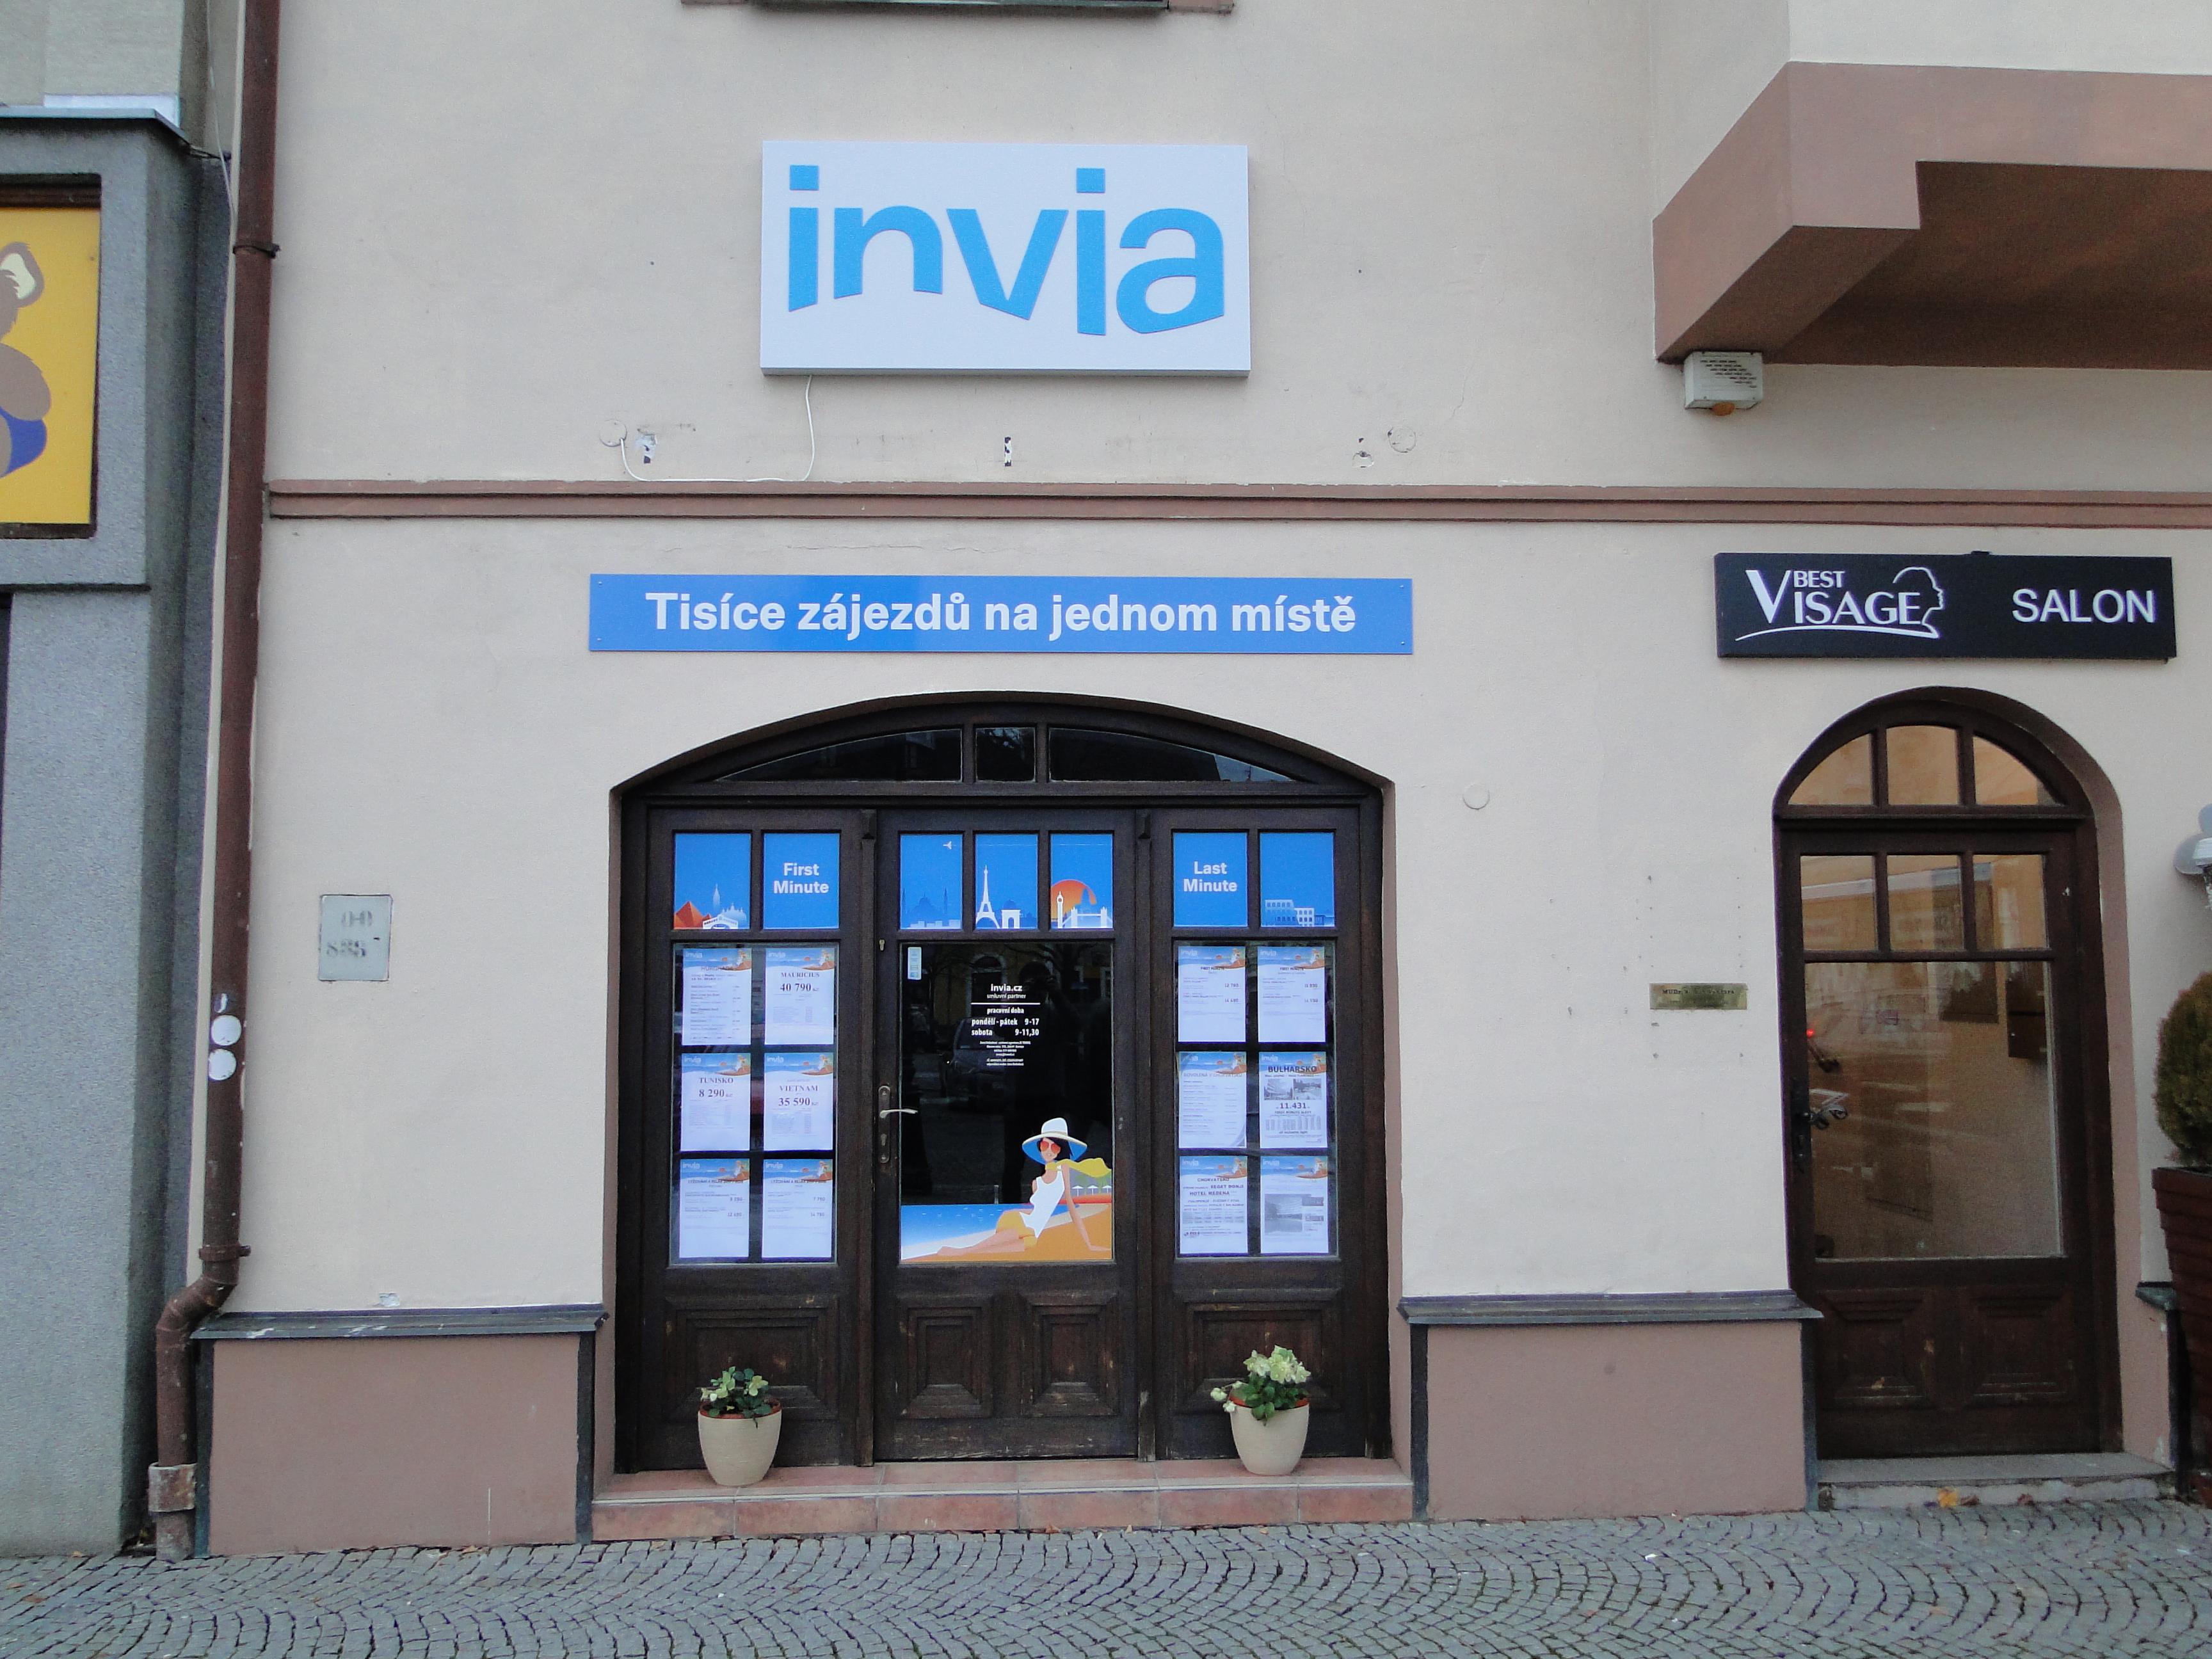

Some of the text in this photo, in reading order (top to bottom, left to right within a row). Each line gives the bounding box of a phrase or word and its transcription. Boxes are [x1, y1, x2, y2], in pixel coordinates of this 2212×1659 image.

[788, 164, 1225, 335] invia
[1793, 570, 1845, 588] BEST
[1745, 570, 1922, 625] VISAGE
[2012, 588, 2155, 623] SALON
[645, 591, 1356, 641] Tisíce zájezdů na jednom místě
[783, 862, 820, 876] First
[1194, 861, 1228, 874] Last
[773, 880, 830, 894] Minute
[1183, 879, 1238, 892] Minute
[780, 983, 791, 991] 40
[795, 983, 812, 991] 790
[972, 1018, 995, 1027] pondělí
[1000, 1018, 1018, 1027] pátek
[699, 1089, 704, 1097] 8
[708, 1089, 725, 1097] 290
[778, 1097, 790, 1106] 35
[793, 1097, 810, 1106] 590
